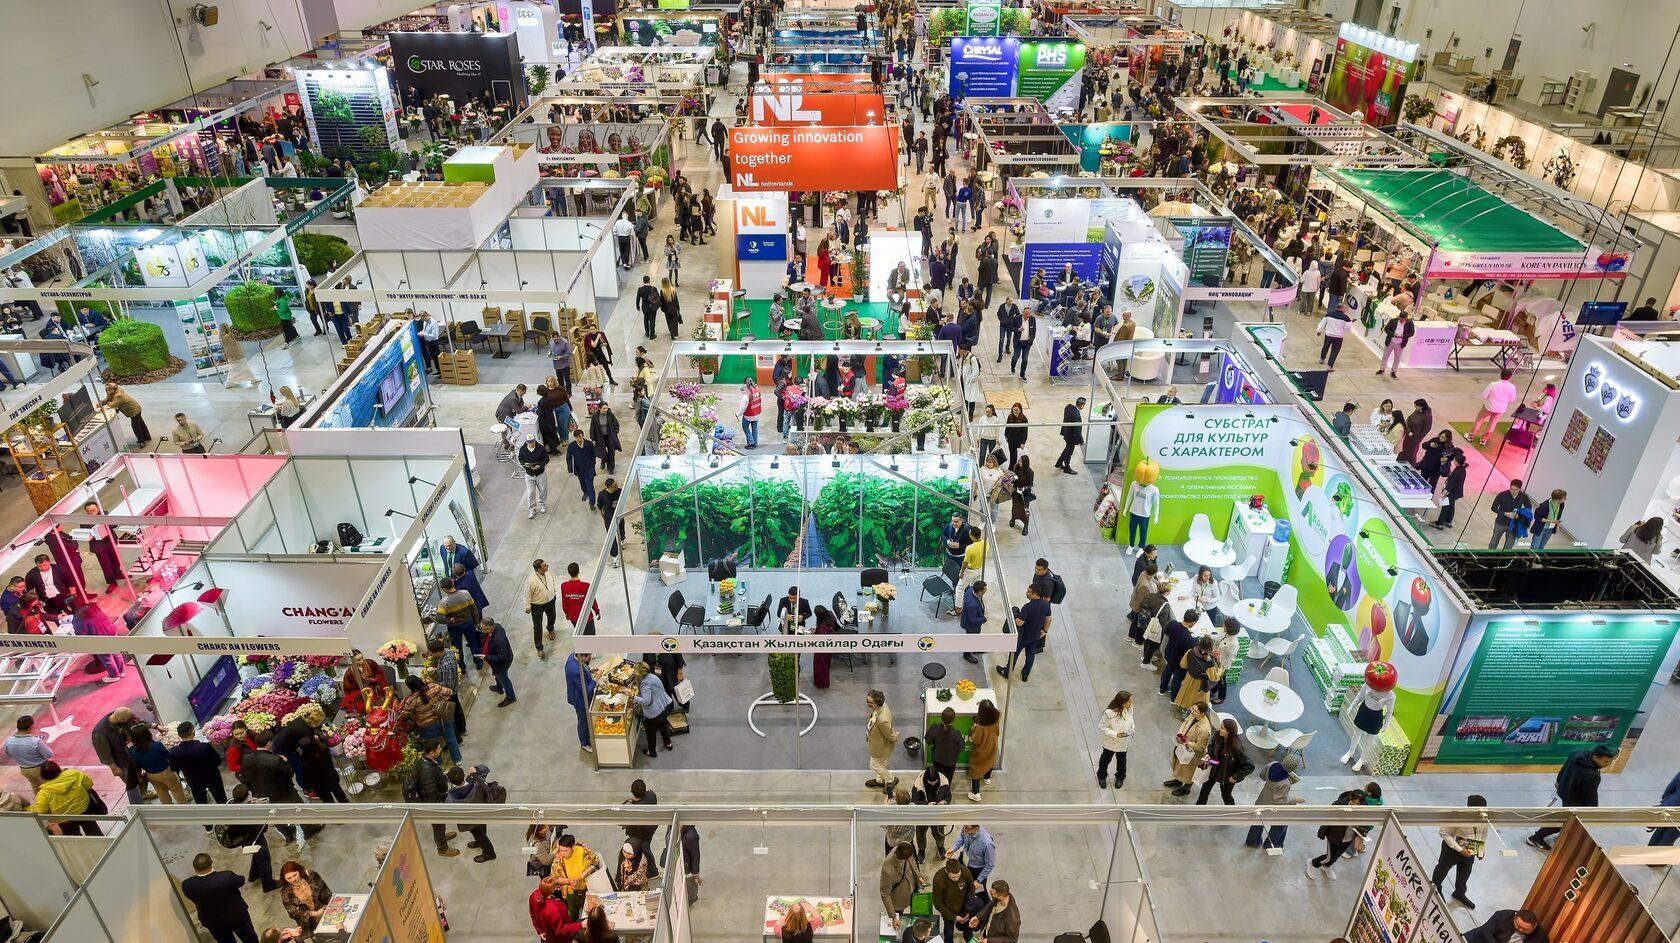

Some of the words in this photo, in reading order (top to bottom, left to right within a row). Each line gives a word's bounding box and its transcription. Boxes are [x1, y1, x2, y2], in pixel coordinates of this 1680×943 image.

[963, 44, 1002, 55] CHRYSAL
[1036, 45, 1067, 63] PHS
[421, 59, 447, 70] STAR
[449, 59, 481, 71] ROSES
[753, 80, 822, 121] NL
[733, 132, 790, 147] Growing
[793, 130, 864, 143] innovation
[734, 152, 793, 167] together
[736, 172, 759, 187] NL
[741, 206, 776, 226] NL
[1204, 418, 1272, 429] СУБСТРАТ
[1174, 432, 1204, 443] ДЛЯ
[1207, 432, 1269, 443] КУЛЬТУР
[1159, 447, 1168, 457] С
[1170, 446, 1265, 457] ХАРАКТЕРОМ
[197, 642, 239, 650] CHANG'AN
[240, 643, 281, 651] FLOWERS
[693, 639, 760, 651] Қазақстан
[764, 639, 858, 651] Жылыжайлар
[861, 638, 904, 649] Одағы
